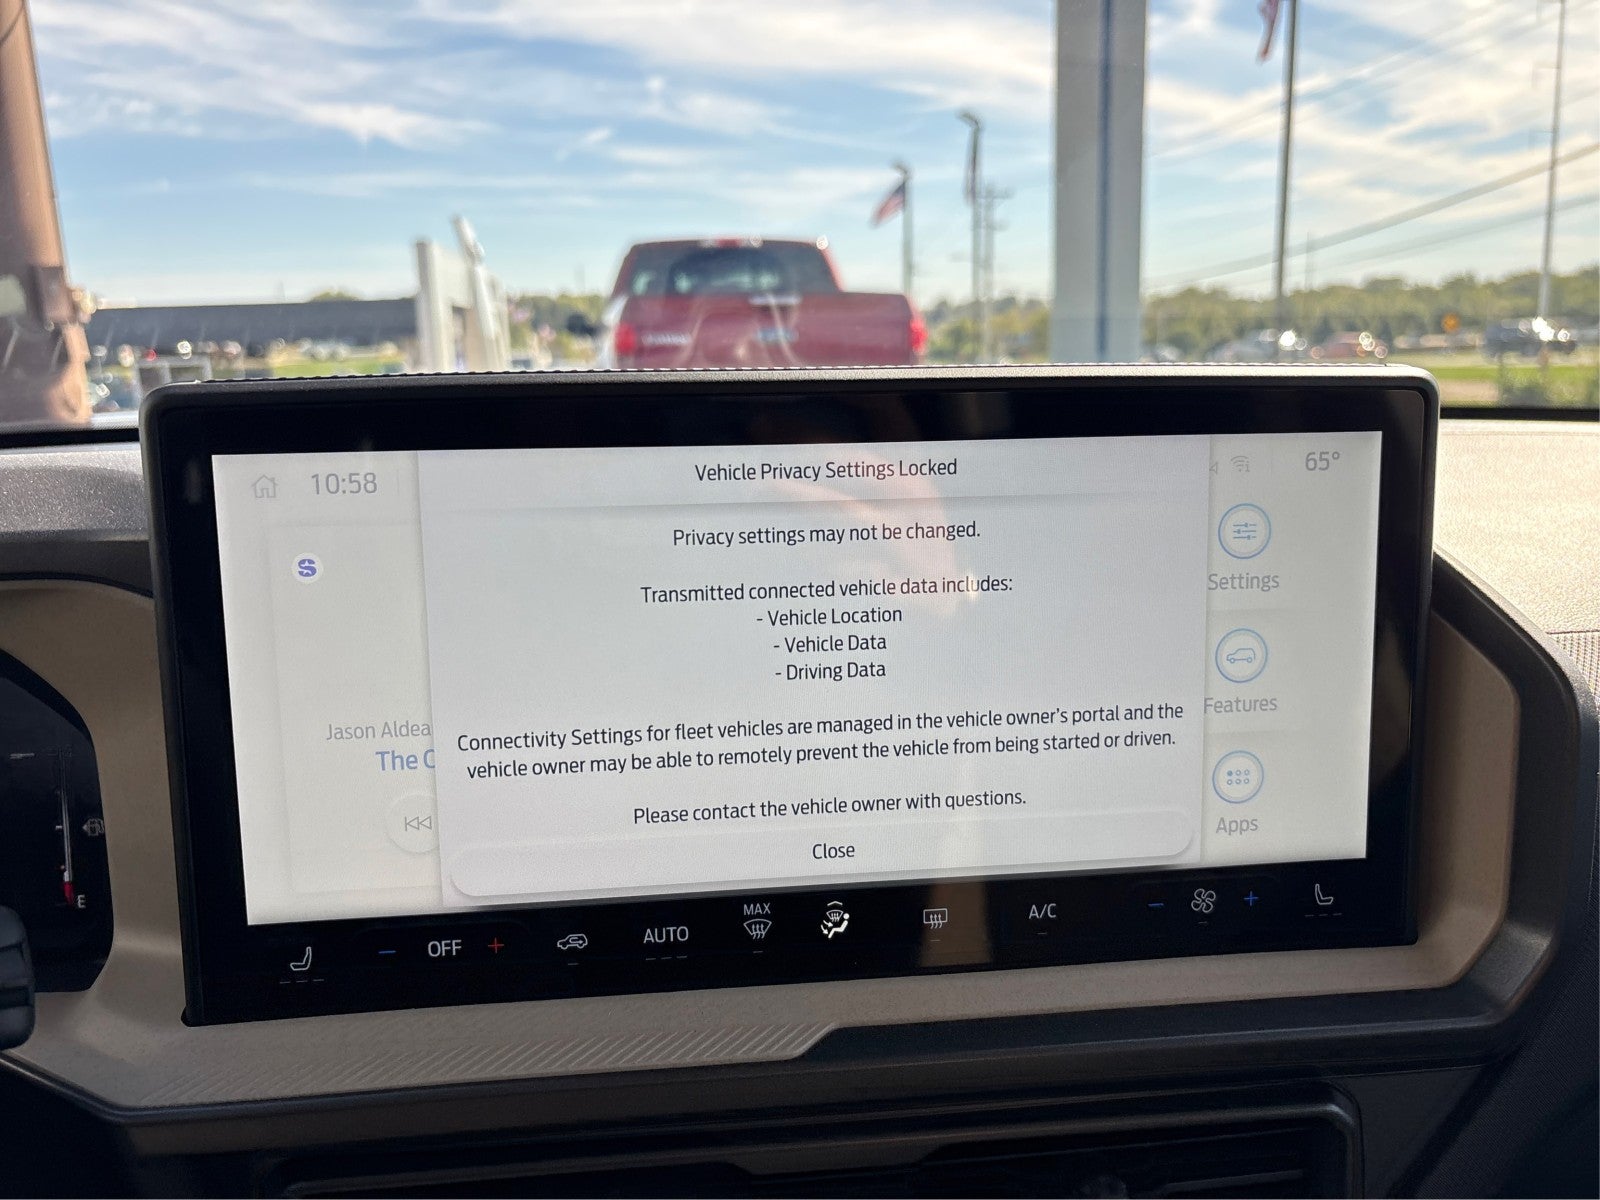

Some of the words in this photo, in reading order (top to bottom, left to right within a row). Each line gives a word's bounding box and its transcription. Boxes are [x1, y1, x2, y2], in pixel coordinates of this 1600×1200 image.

[694, 462, 757, 482] Vehicle
[760, 462, 822, 483] Privacy
[825, 460, 895, 481] Settings
[899, 457, 958, 477] Locked
[310, 472, 378, 495] 10:58
[673, 528, 735, 548] Privacy
[738, 526, 806, 547] settings
[809, 528, 846, 545] may
[849, 524, 879, 542] not
[882, 522, 902, 541] be
[905, 520, 981, 542] changed.
[639, 582, 745, 604] Transmitted
[748, 579, 836, 600] connected
[838, 578, 897, 597] vehicle
[900, 577, 939, 595] data
[942, 574, 1013, 594] includes:
[1208, 572, 1280, 592] Settings
[767, 607, 827, 627] Vehicle
[831, 606, 903, 625] Location
[783, 634, 844, 654] Vehicle
[847, 634, 888, 651] Data
[786, 662, 843, 682] Driving
[847, 661, 887, 679] Data
[1204, 696, 1278, 714] Features
[326, 722, 376, 741] Jason
[457, 730, 567, 752] Connectivity
[571, 727, 643, 747] Settings
[646, 724, 672, 742] for
[674, 722, 714, 741] fleet
[717, 719, 784, 739] vehicles
[787, 721, 813, 735] are
[816, 713, 894, 735] managed
[897, 713, 912, 731] in
[915, 712, 943, 730] the
[945, 709, 1003, 729] vehicle
[1005, 707, 1069, 726] owner's
[1072, 704, 1120, 727] portal
[1123, 703, 1154, 721] and
[1156, 702, 1184, 720] the
[375, 749, 419, 772] The
[466, 759, 528, 780] vehicle
[531, 759, 587, 776] owner
[590, 757, 628, 774] may
[631, 752, 653, 771] be
[655, 750, 693, 769] able
[695, 750, 714, 767] to
[718, 745, 793, 766] remotely
[796, 743, 859, 765] prevent
[861, 741, 890, 759] the
[892, 738, 949, 758] vehicle
[952, 737, 992, 755] from
[995, 735, 1040, 755] being
[1042, 731, 1100, 751] started
[1103, 734, 1121, 748] or
[1123, 730, 1176, 747] driven.
[633, 806, 689, 825] Please
[692, 801, 757, 822] contact
[759, 799, 788, 818] the
[790, 796, 848, 816] vehicle
[851, 797, 902, 813] owner
[904, 791, 941, 810] with
[944, 789, 1027, 811] questions.
[1215, 816, 1259, 836] Apps
[812, 842, 856, 860] Close
[77, 894, 87, 909] E
[743, 902, 772, 916] MAX
[1028, 902, 1057, 920] A/C
[642, 925, 690, 944] AUTO
[427, 939, 463, 958] OFF
